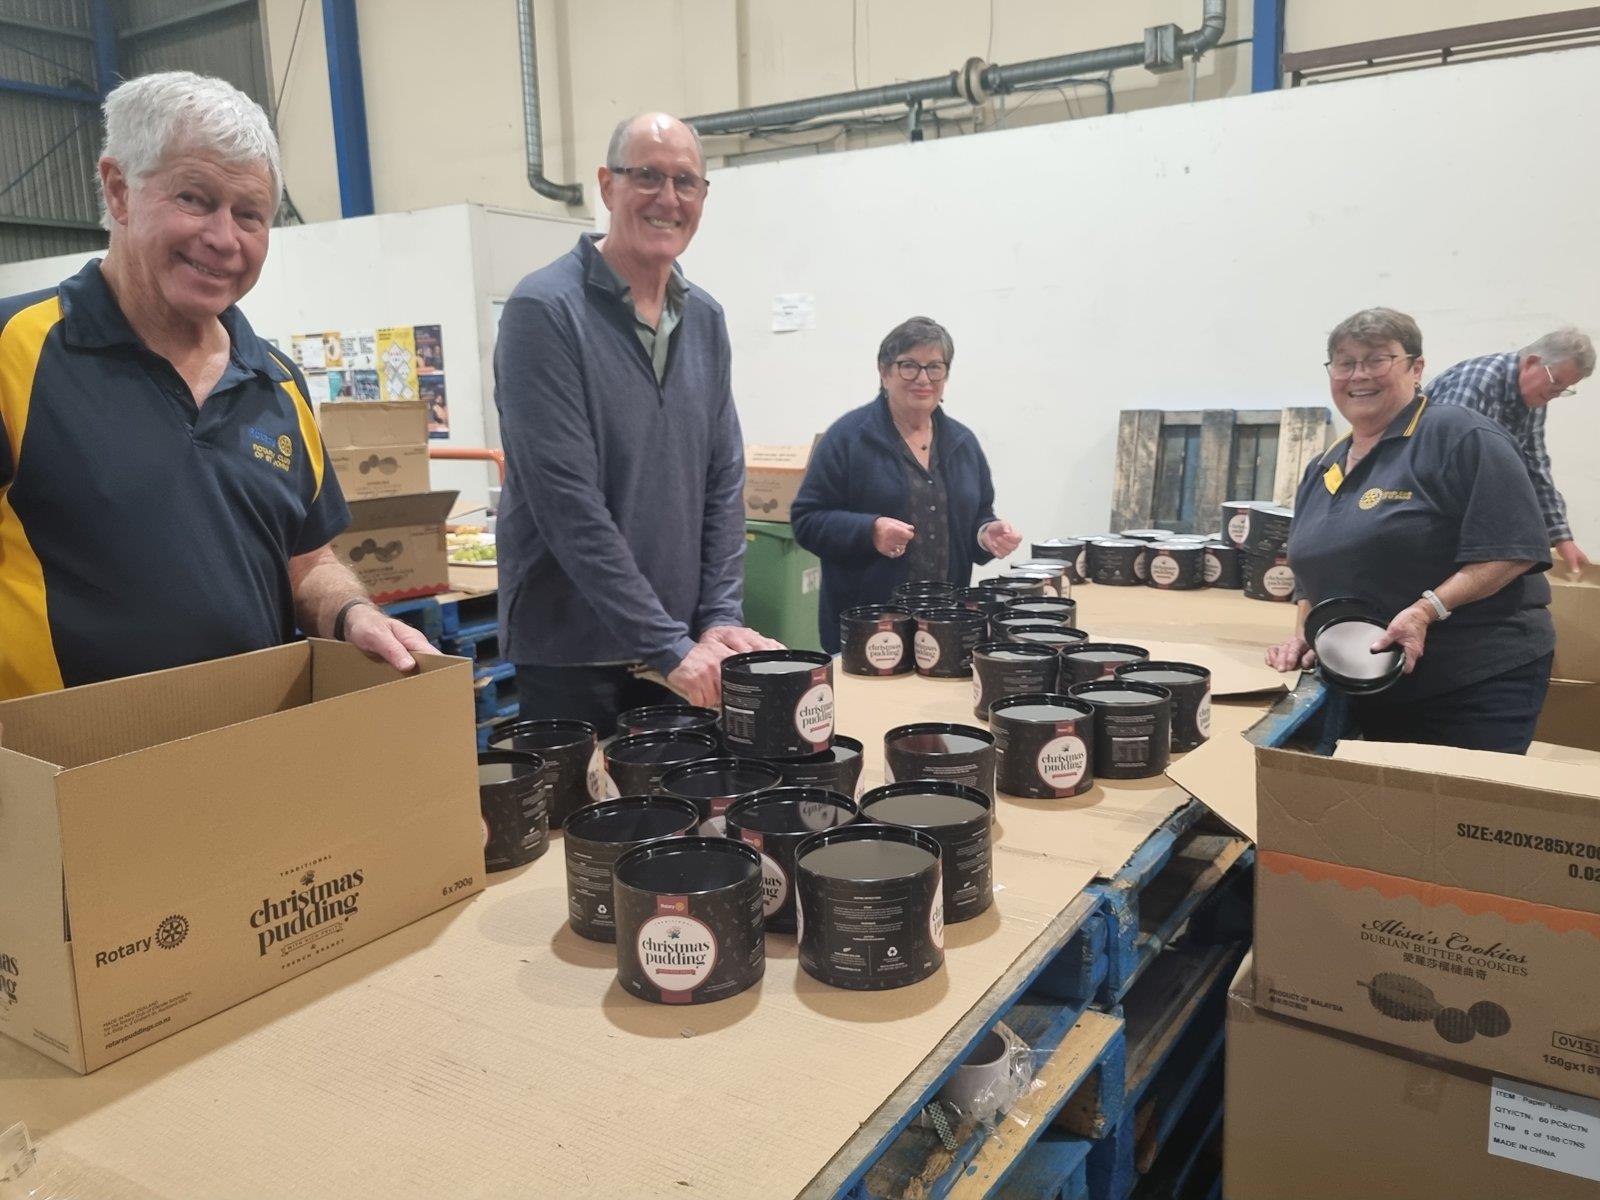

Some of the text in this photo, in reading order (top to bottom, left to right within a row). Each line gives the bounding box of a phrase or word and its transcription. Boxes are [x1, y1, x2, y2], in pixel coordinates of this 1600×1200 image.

[250, 868, 364, 929] christmas
[258, 892, 359, 956] pudding
[95, 937, 152, 968] Rotary
[642, 937, 710, 953] christmas
[1361, 919, 1528, 964] Alisa's Cookies
[1361, 931, 1529, 977] DURIAN BUTTER COOKIES
[645, 953, 707, 969] pudding
[105, 1016, 171, 1050] rotarypuddings.co.nz
[1493, 1137, 1556, 1158] MADE IN CHINA
